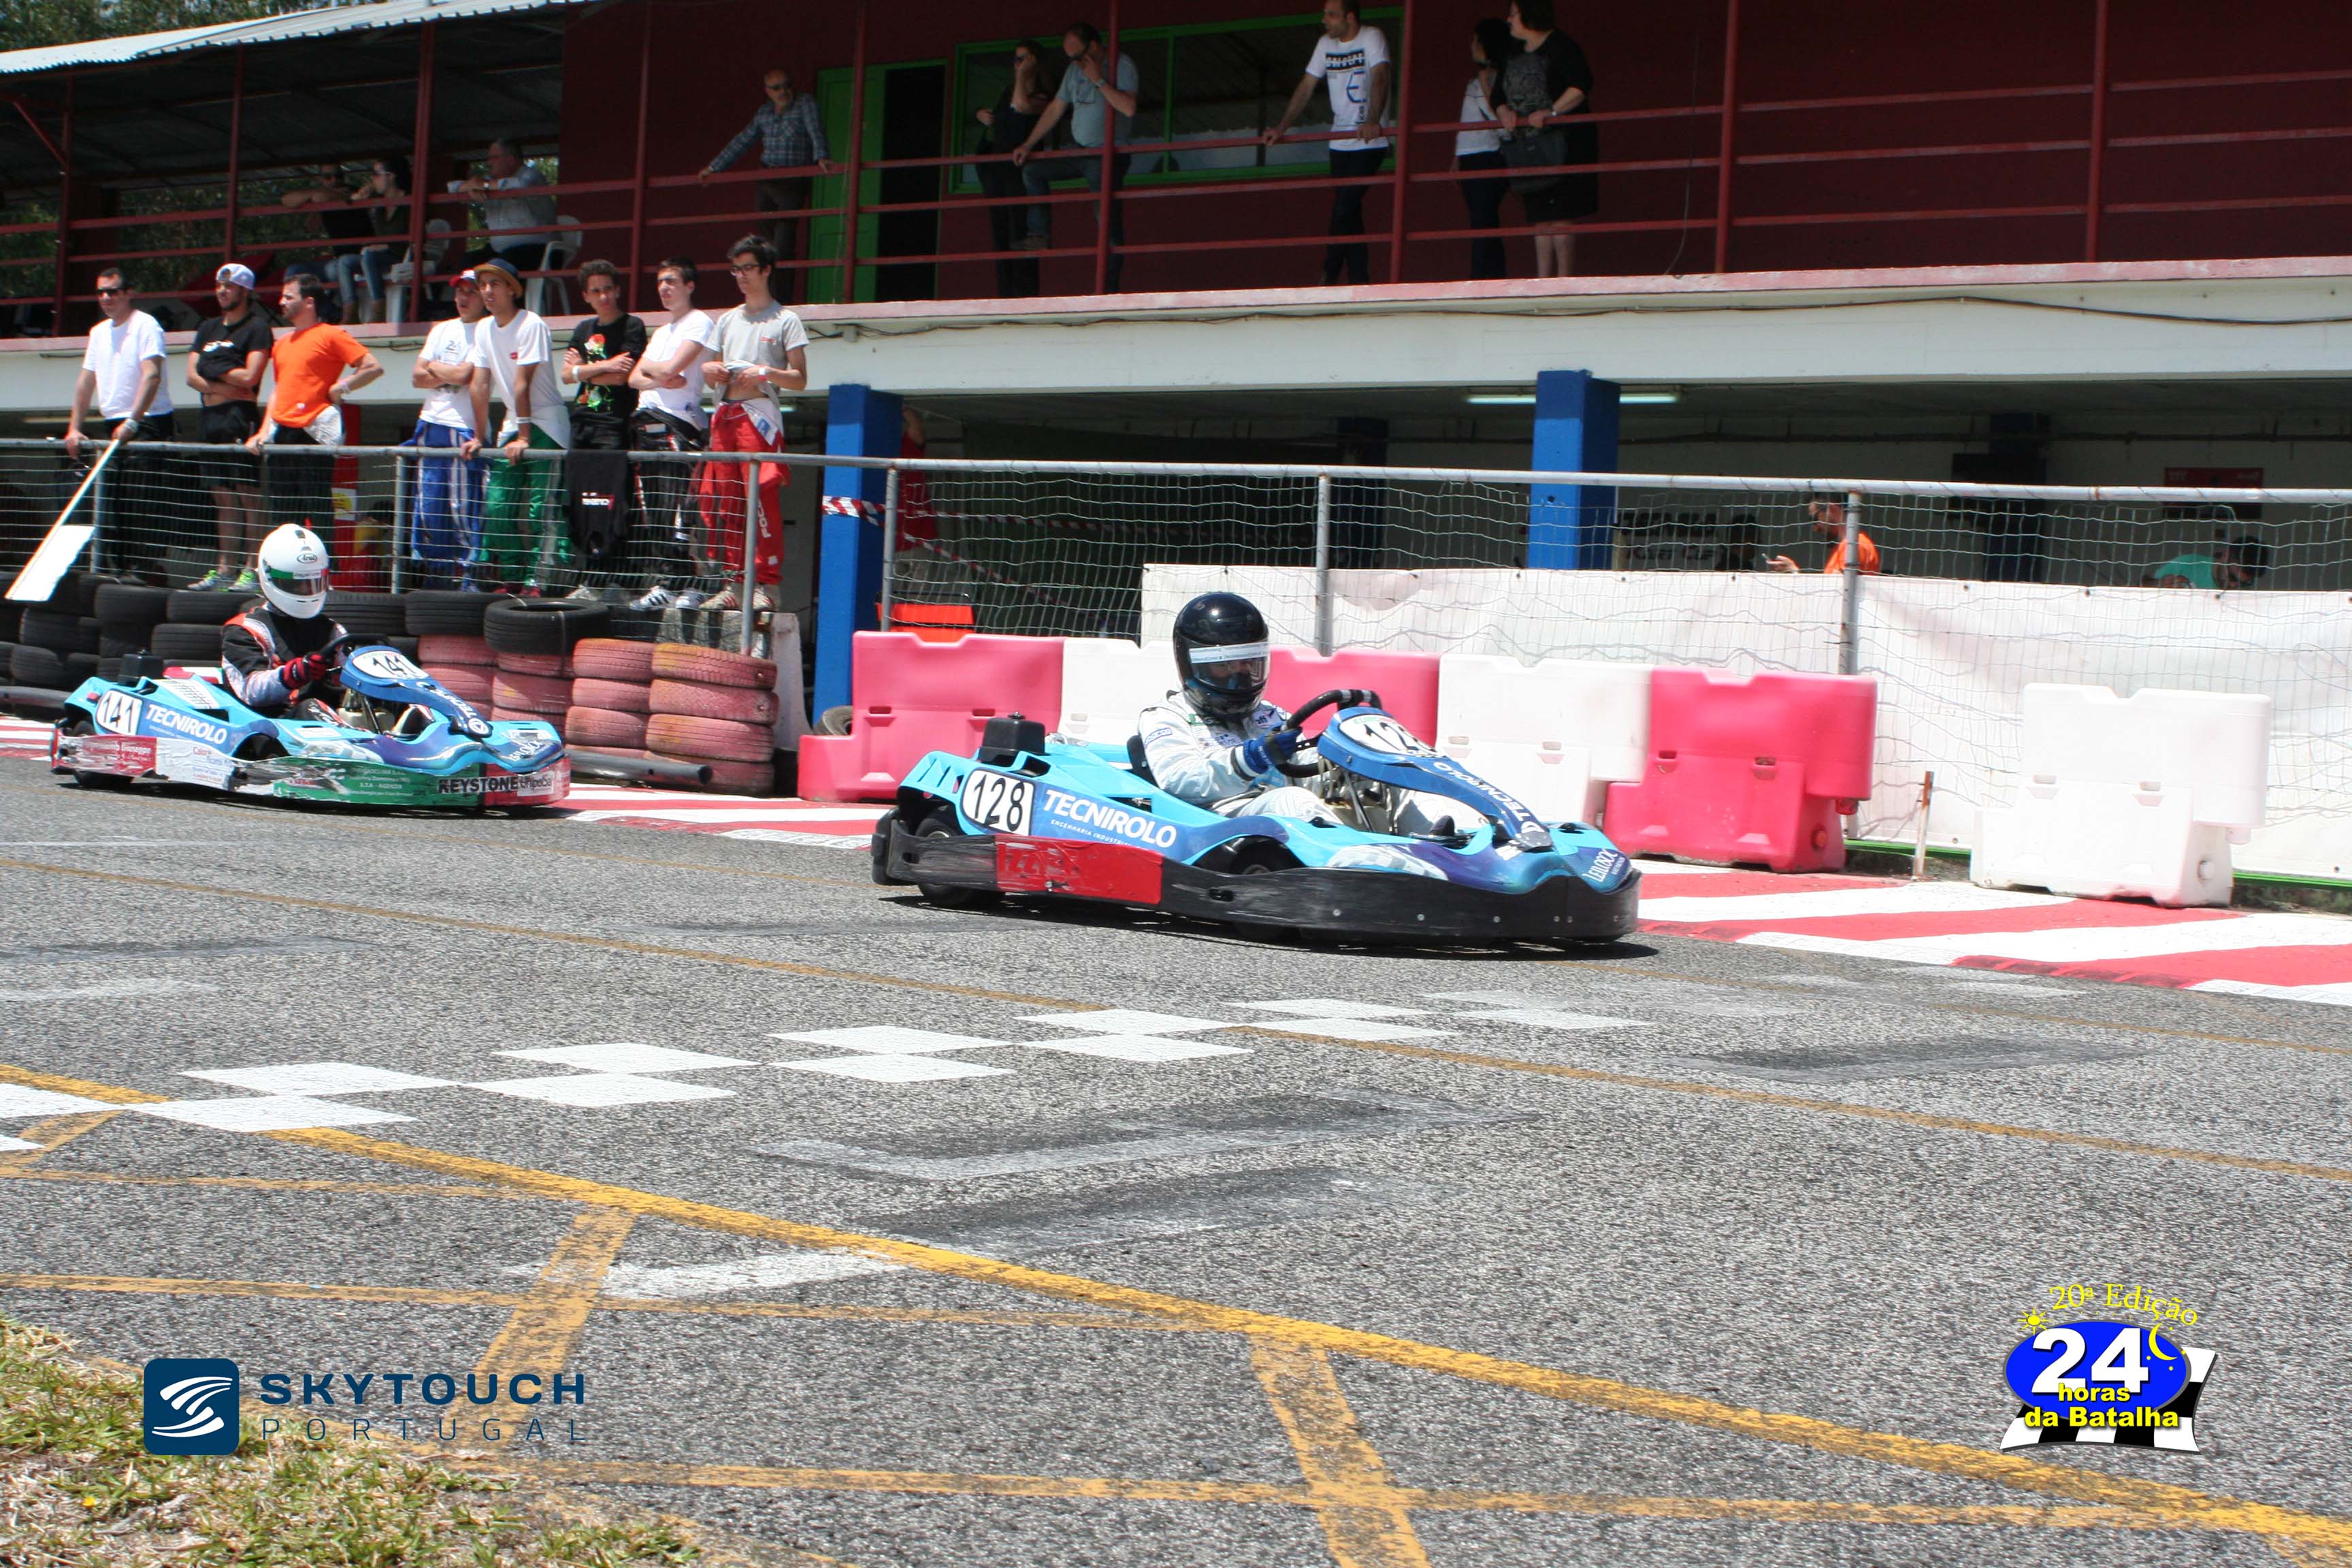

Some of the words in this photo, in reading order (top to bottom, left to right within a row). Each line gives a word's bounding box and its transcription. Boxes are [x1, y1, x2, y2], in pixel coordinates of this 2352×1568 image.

[372, 655, 417, 676] 141
[103, 692, 133, 733] 141
[146, 704, 227, 745] TECNIROLO
[438, 776, 518, 794] KEYSTONE
[974, 774, 1025, 832] 128
[1043, 789, 1177, 848] TECNIROLO
